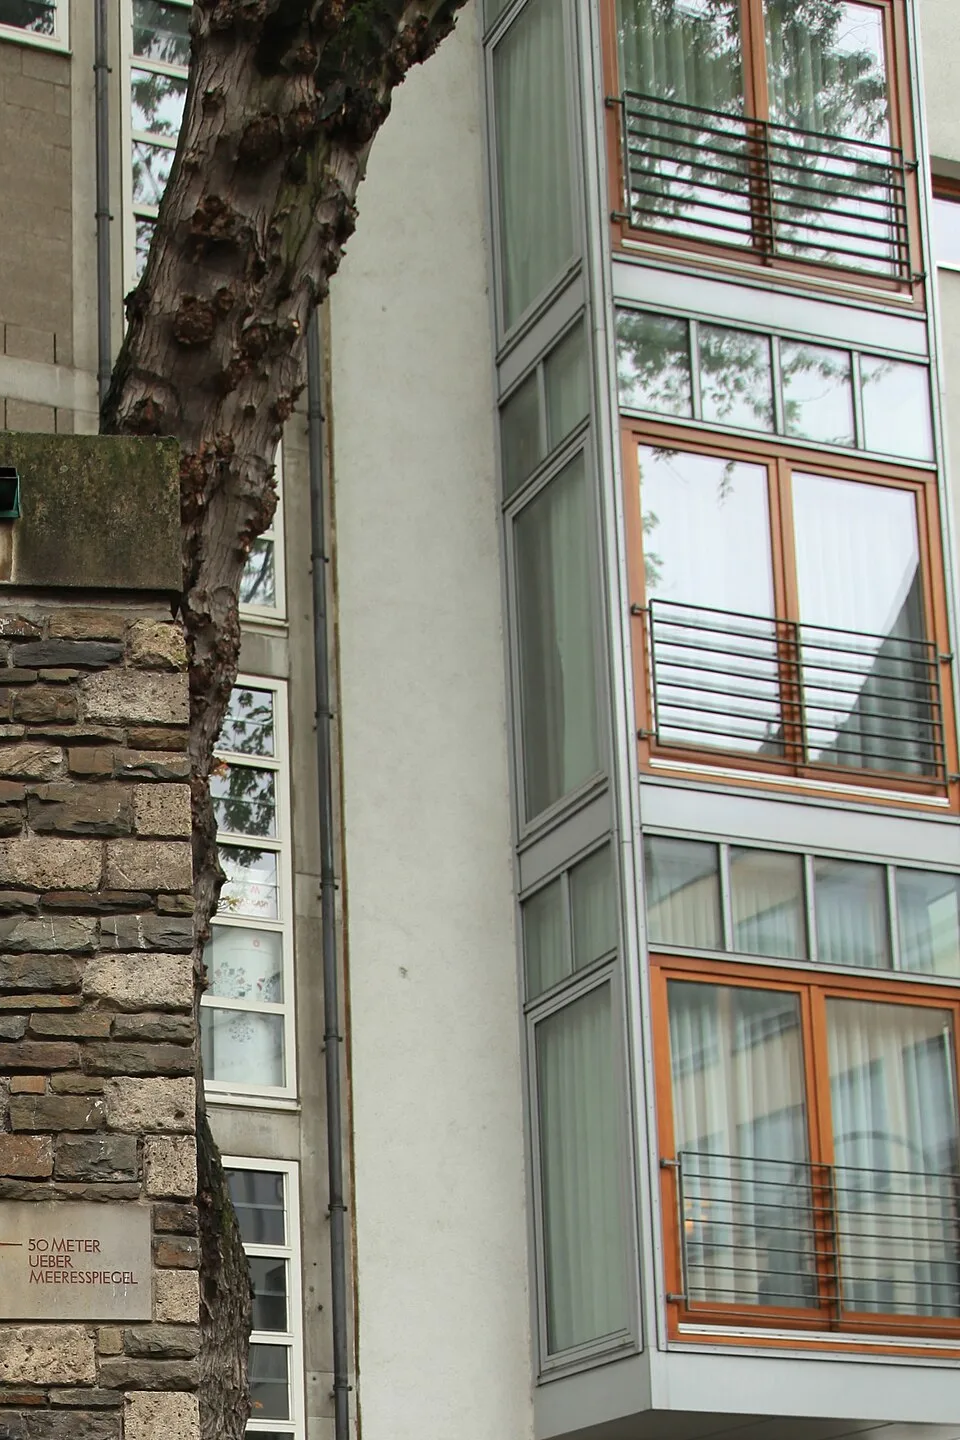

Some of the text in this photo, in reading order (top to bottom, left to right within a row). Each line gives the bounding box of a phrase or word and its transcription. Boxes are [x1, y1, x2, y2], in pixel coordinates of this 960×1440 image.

[28, 1238, 101, 1253] 50 METER
[29, 1255, 74, 1269] UEBER
[29, 1270, 138, 1284] MEERESSPIEGEL
